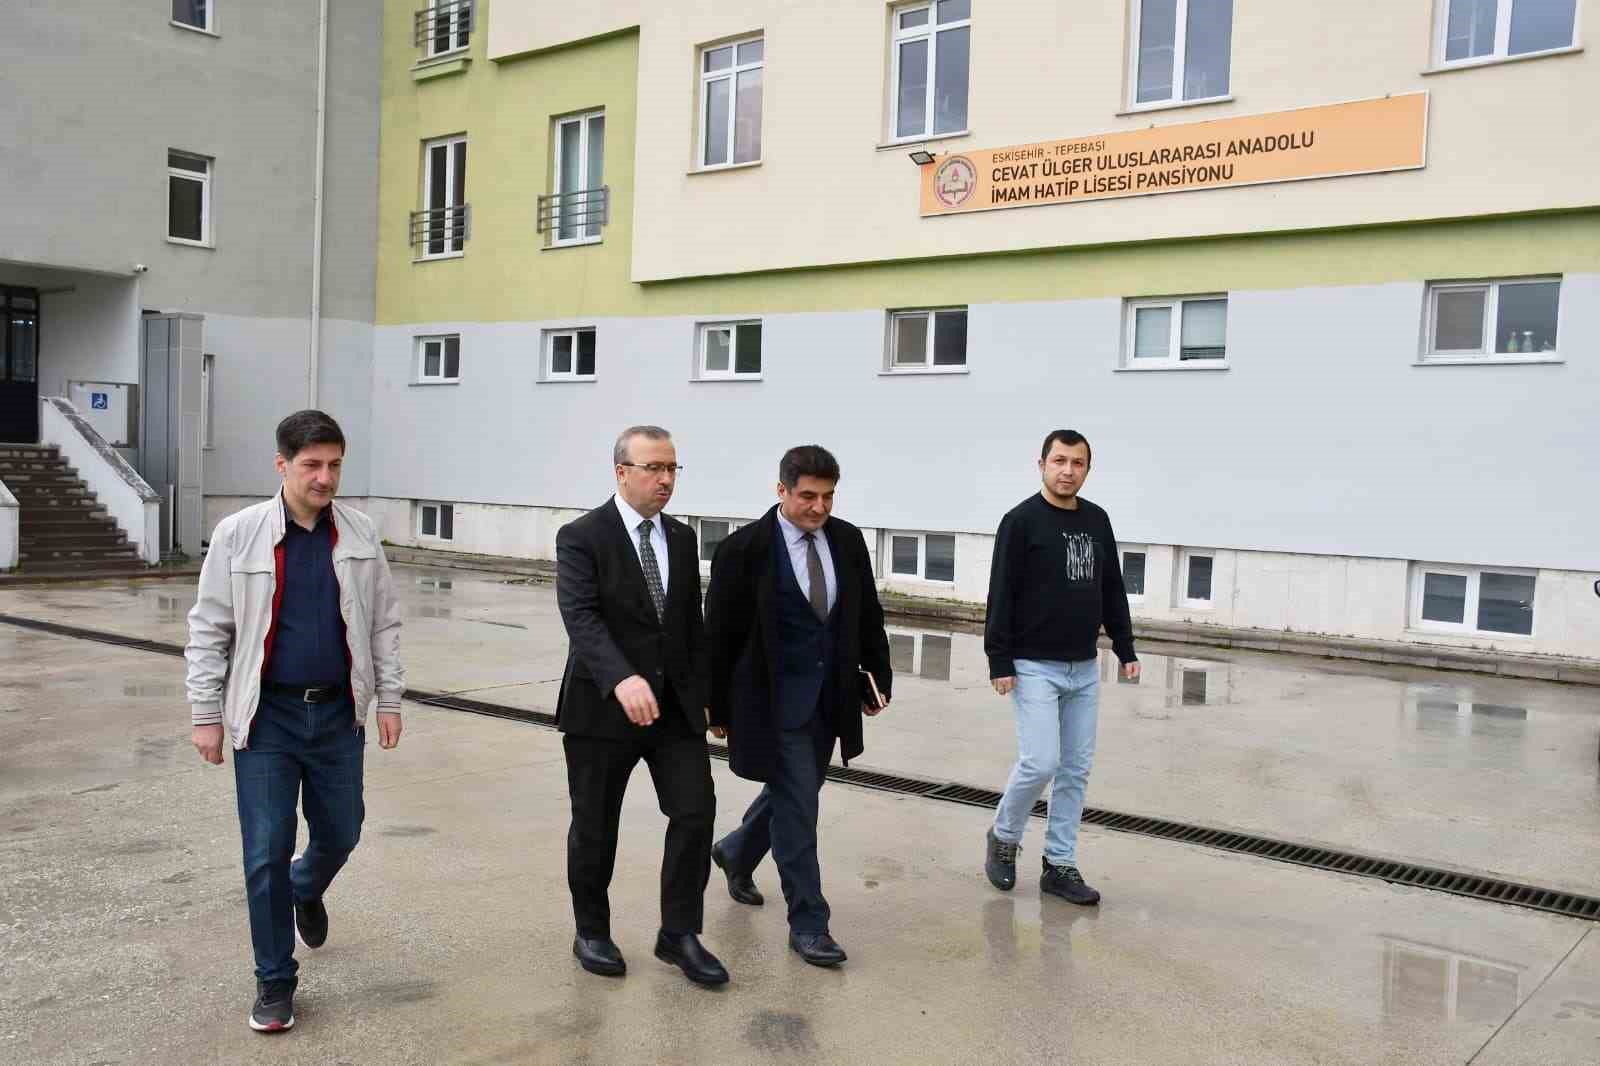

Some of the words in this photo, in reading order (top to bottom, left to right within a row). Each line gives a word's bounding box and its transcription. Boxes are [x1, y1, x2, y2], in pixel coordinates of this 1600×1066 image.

[992, 163, 1038, 182] CEVAT
[1042, 157, 1092, 177] ÜLGER
[1096, 142, 1221, 170] ULUSLARARASI
[1225, 131, 1314, 156] ANADOLU
[991, 185, 1030, 203] İMAM
[1034, 177, 1079, 199] HATİP
[1083, 171, 1132, 194] LİSESİ
[1136, 163, 1234, 189] PANSİYONU
